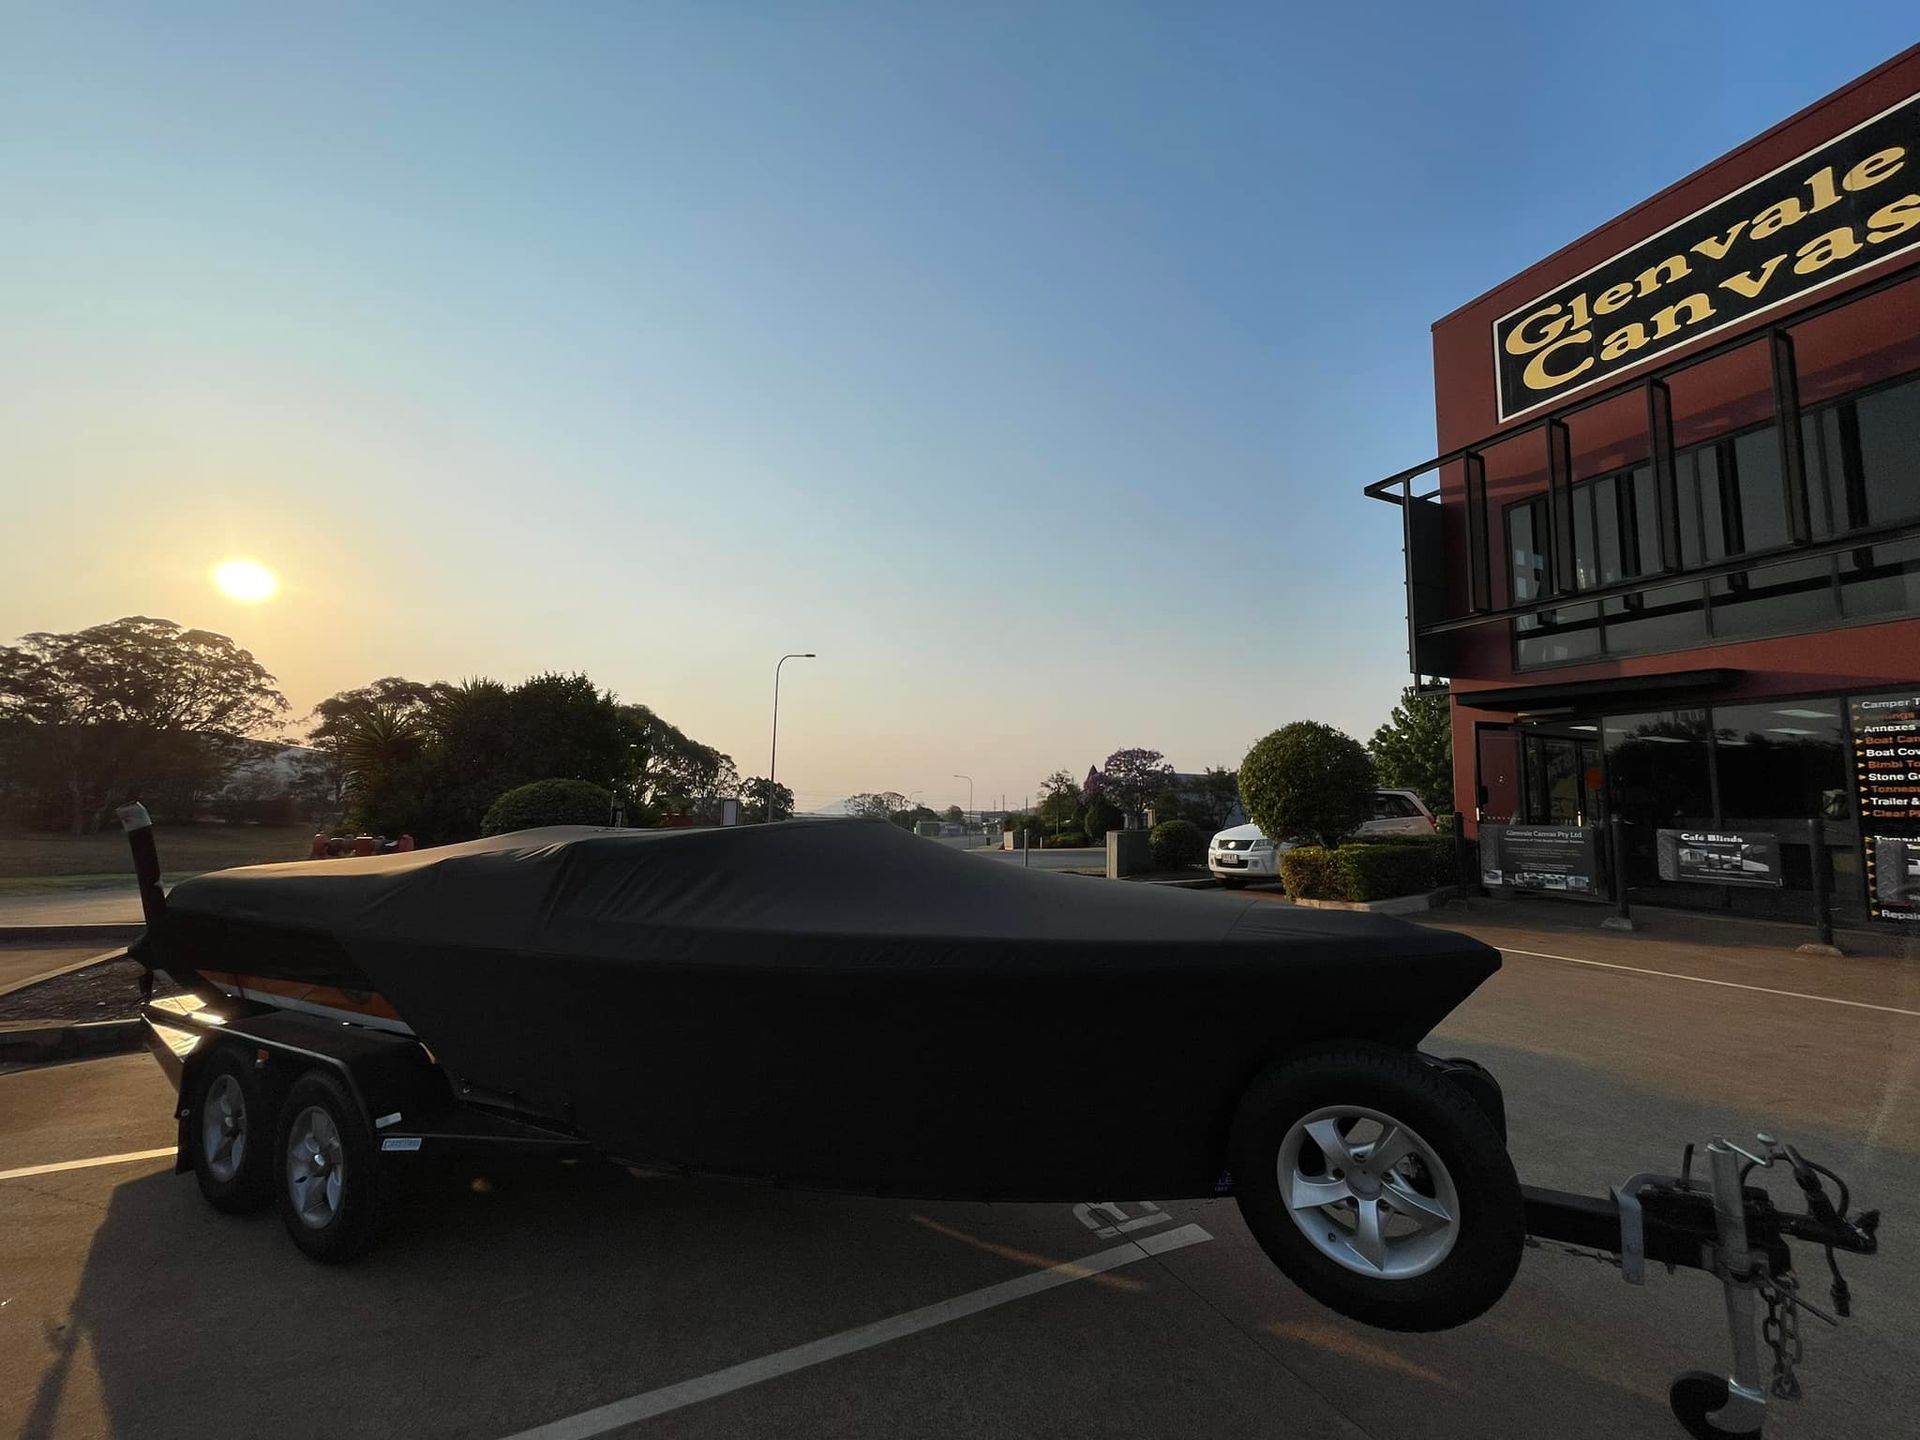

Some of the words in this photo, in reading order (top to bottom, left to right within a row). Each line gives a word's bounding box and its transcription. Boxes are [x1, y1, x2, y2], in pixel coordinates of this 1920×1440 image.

[1504, 145, 1908, 356] Glenvale
[1522, 193, 1920, 390] Canvas
[1861, 700, 1911, 709] Camper
[1864, 723, 1916, 733] Annexes
[1865, 736, 1893, 745] Boat
[1866, 748, 1895, 757] Boat
[1868, 772, 1904, 781] Stone
[1869, 797, 1909, 806] Trailer
[1911, 797, 1920, 806] &
[1872, 809, 1906, 818] Clear
[1680, 833, 1705, 841] Café
[1707, 834, 1744, 843] Blinds
